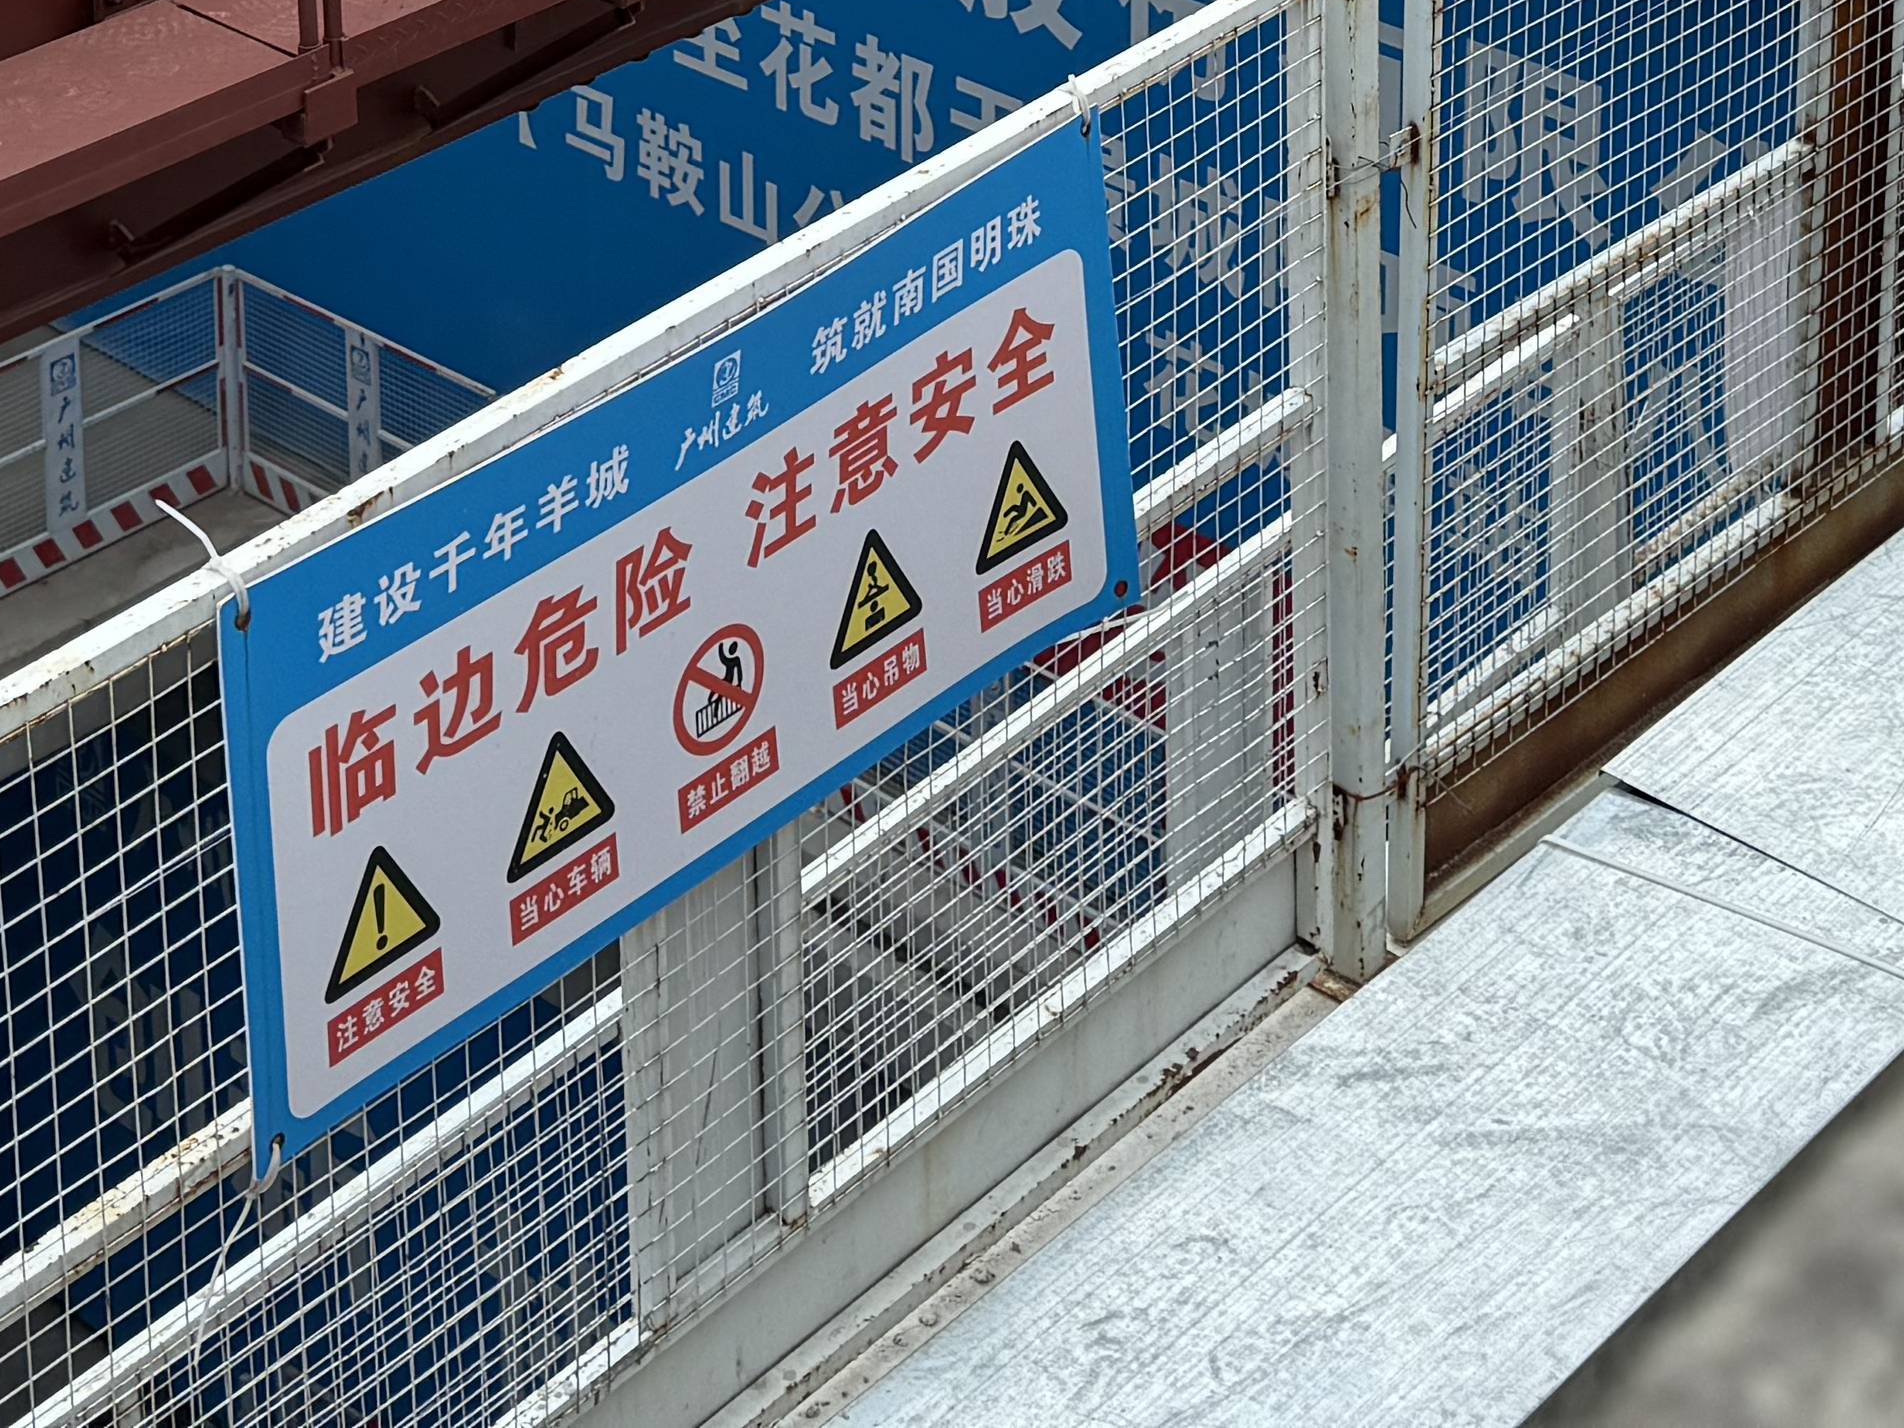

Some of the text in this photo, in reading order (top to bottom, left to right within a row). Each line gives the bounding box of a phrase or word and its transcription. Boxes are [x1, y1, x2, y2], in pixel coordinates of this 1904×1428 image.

[318, 194, 1042, 664] 建设千年羊城 广州建筑 筑就南国明珠
[307, 306, 1056, 839] 临边危险 注意安全
[985, 550, 1068, 621] 当心滑跌
[839, 641, 922, 716] 当心吊物
[686, 741, 772, 820] 禁止翻越
[519, 846, 613, 933] 当心车辆
[335, 964, 437, 1055] 注意安全
